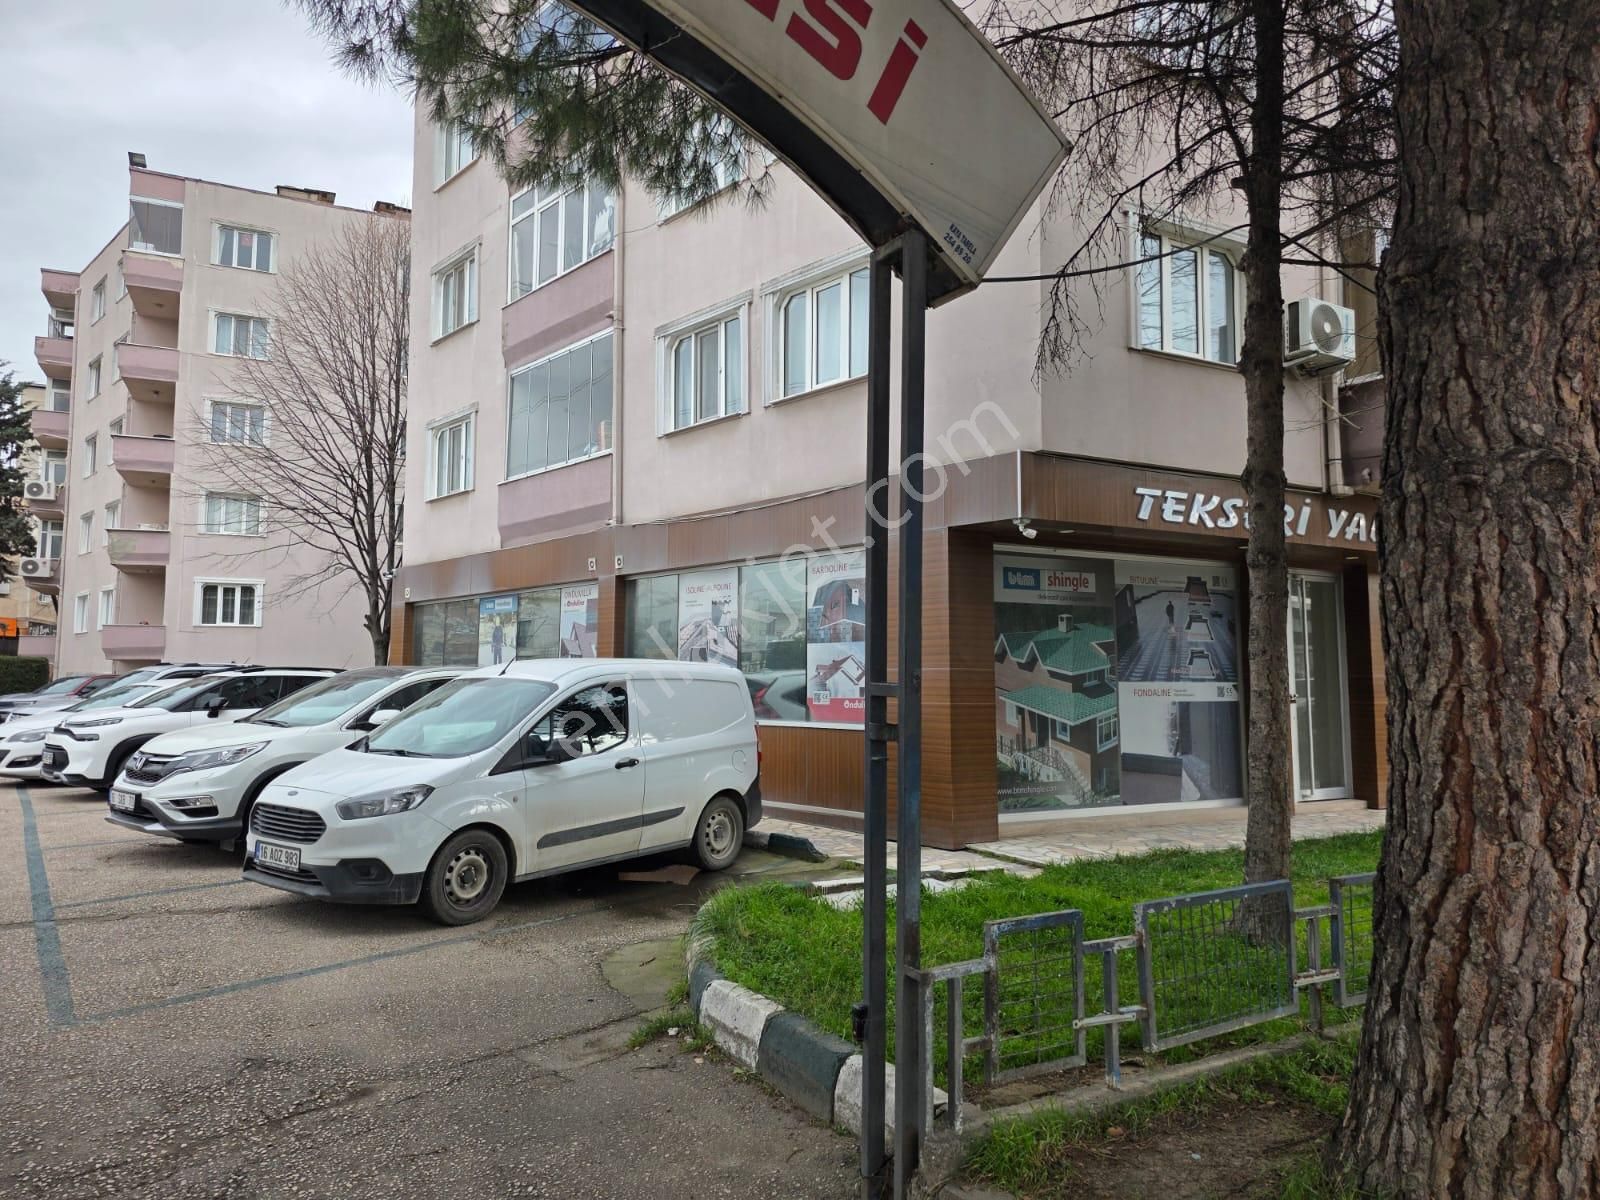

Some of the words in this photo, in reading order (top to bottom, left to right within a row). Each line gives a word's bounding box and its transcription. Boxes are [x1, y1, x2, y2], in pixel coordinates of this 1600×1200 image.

[743, 0, 929, 126] Sİ
[1135, 487, 1311, 537] TEKSRİ
[1328, 508, 1376, 543] YA
[1047, 572, 1089, 592] shingle
[1133, 687, 1172, 697] FONDALINE
[260, 845, 268, 859] 16
[285, 851, 298, 867] 983
